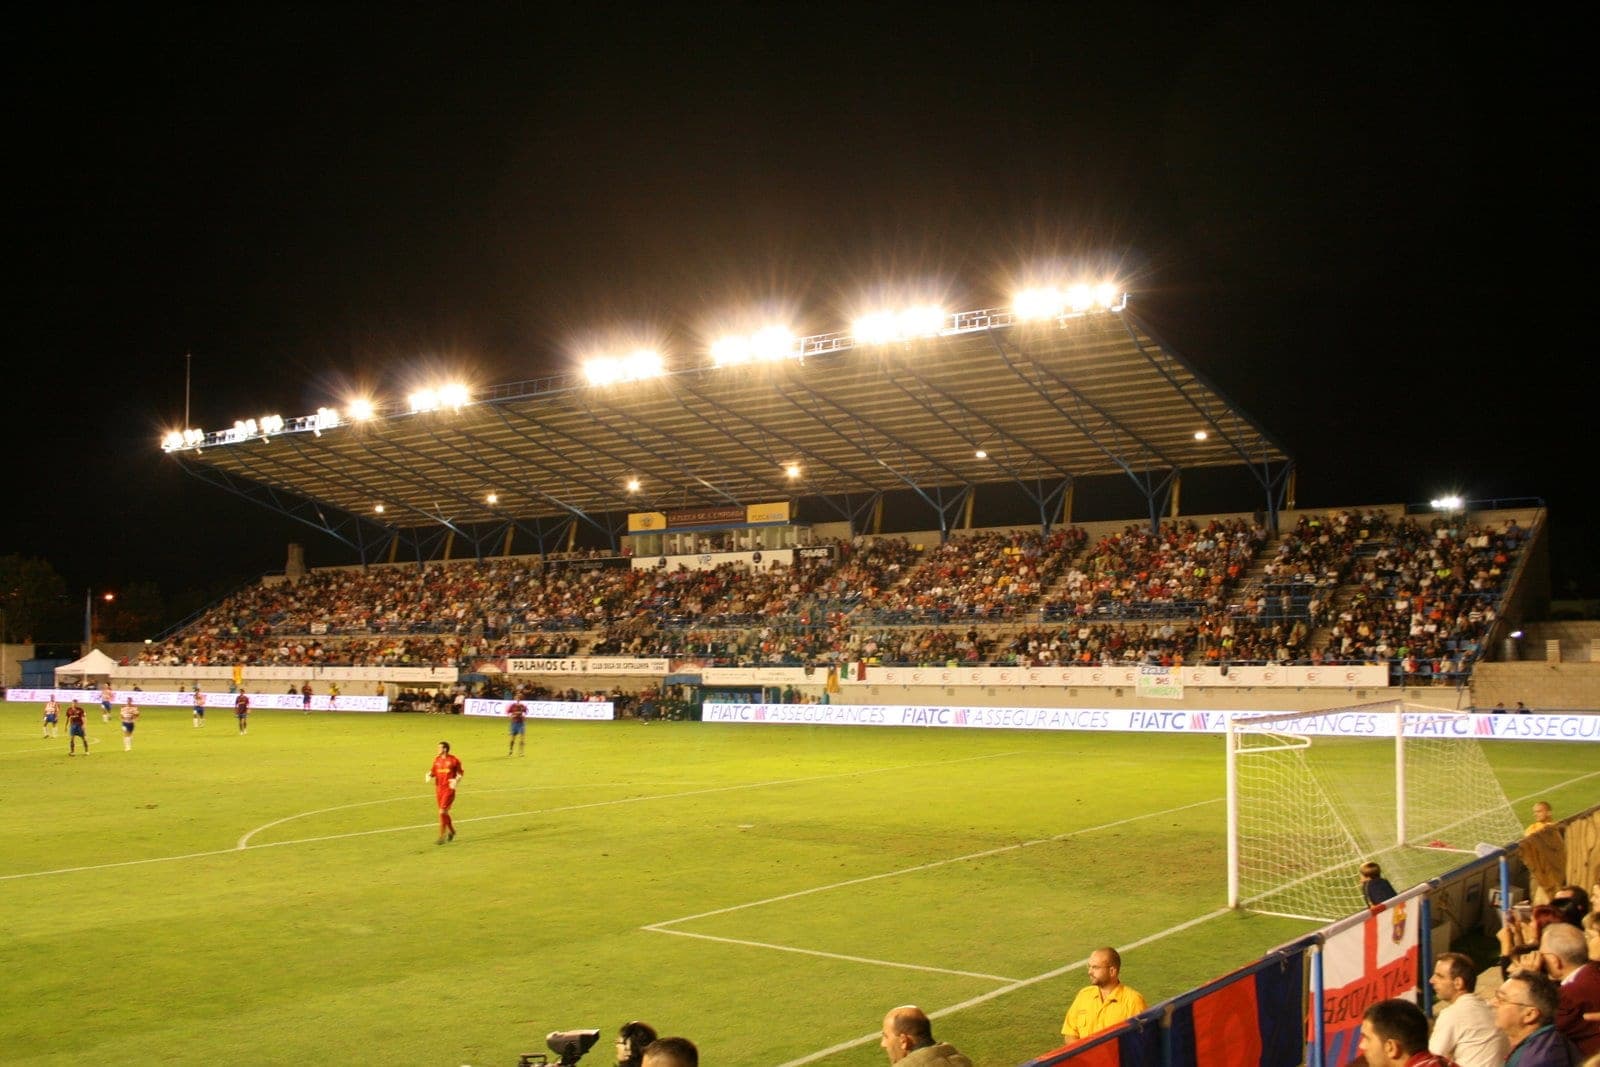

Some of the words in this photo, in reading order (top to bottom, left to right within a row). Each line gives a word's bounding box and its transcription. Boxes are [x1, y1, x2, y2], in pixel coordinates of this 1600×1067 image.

[470, 700, 502, 714] FIATC
[710, 705, 750, 720] FIATC
[771, 706, 886, 723] ASSEGURANCES
[902, 707, 950, 724] FIATC
[975, 709, 1110, 728] ASSEGURANCES
[1129, 711, 1186, 730] FIATC
[1402, 715, 1469, 735] FIATC
[1503, 716, 1600, 738] ASSEGU
